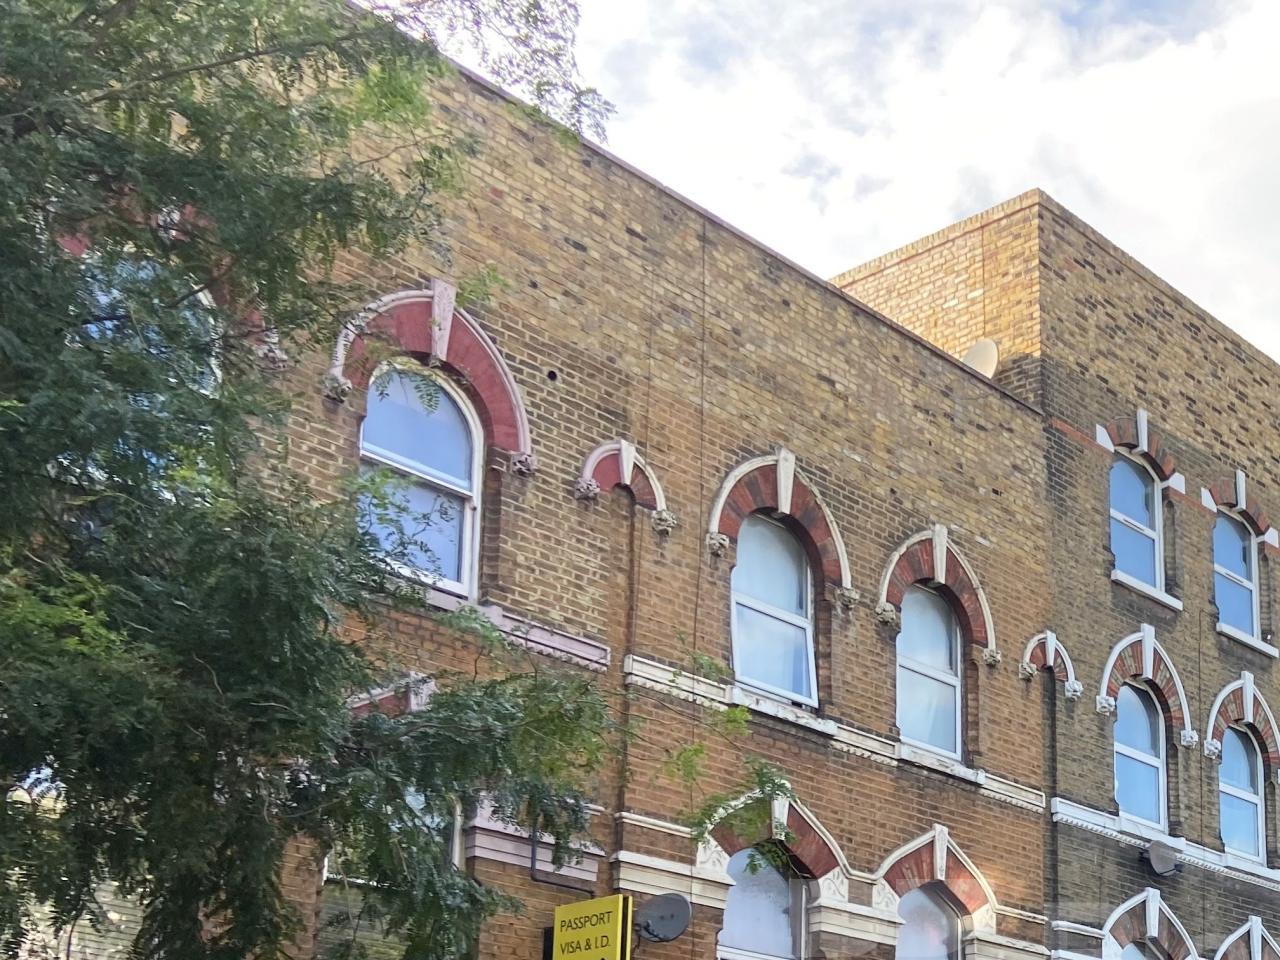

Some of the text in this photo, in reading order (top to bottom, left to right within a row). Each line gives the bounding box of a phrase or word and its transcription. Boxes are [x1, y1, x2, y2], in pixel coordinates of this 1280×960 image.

[560, 911, 613, 932] PASSPORT
[560, 941, 582, 955] VISA
[584, 938, 592, 951] &
